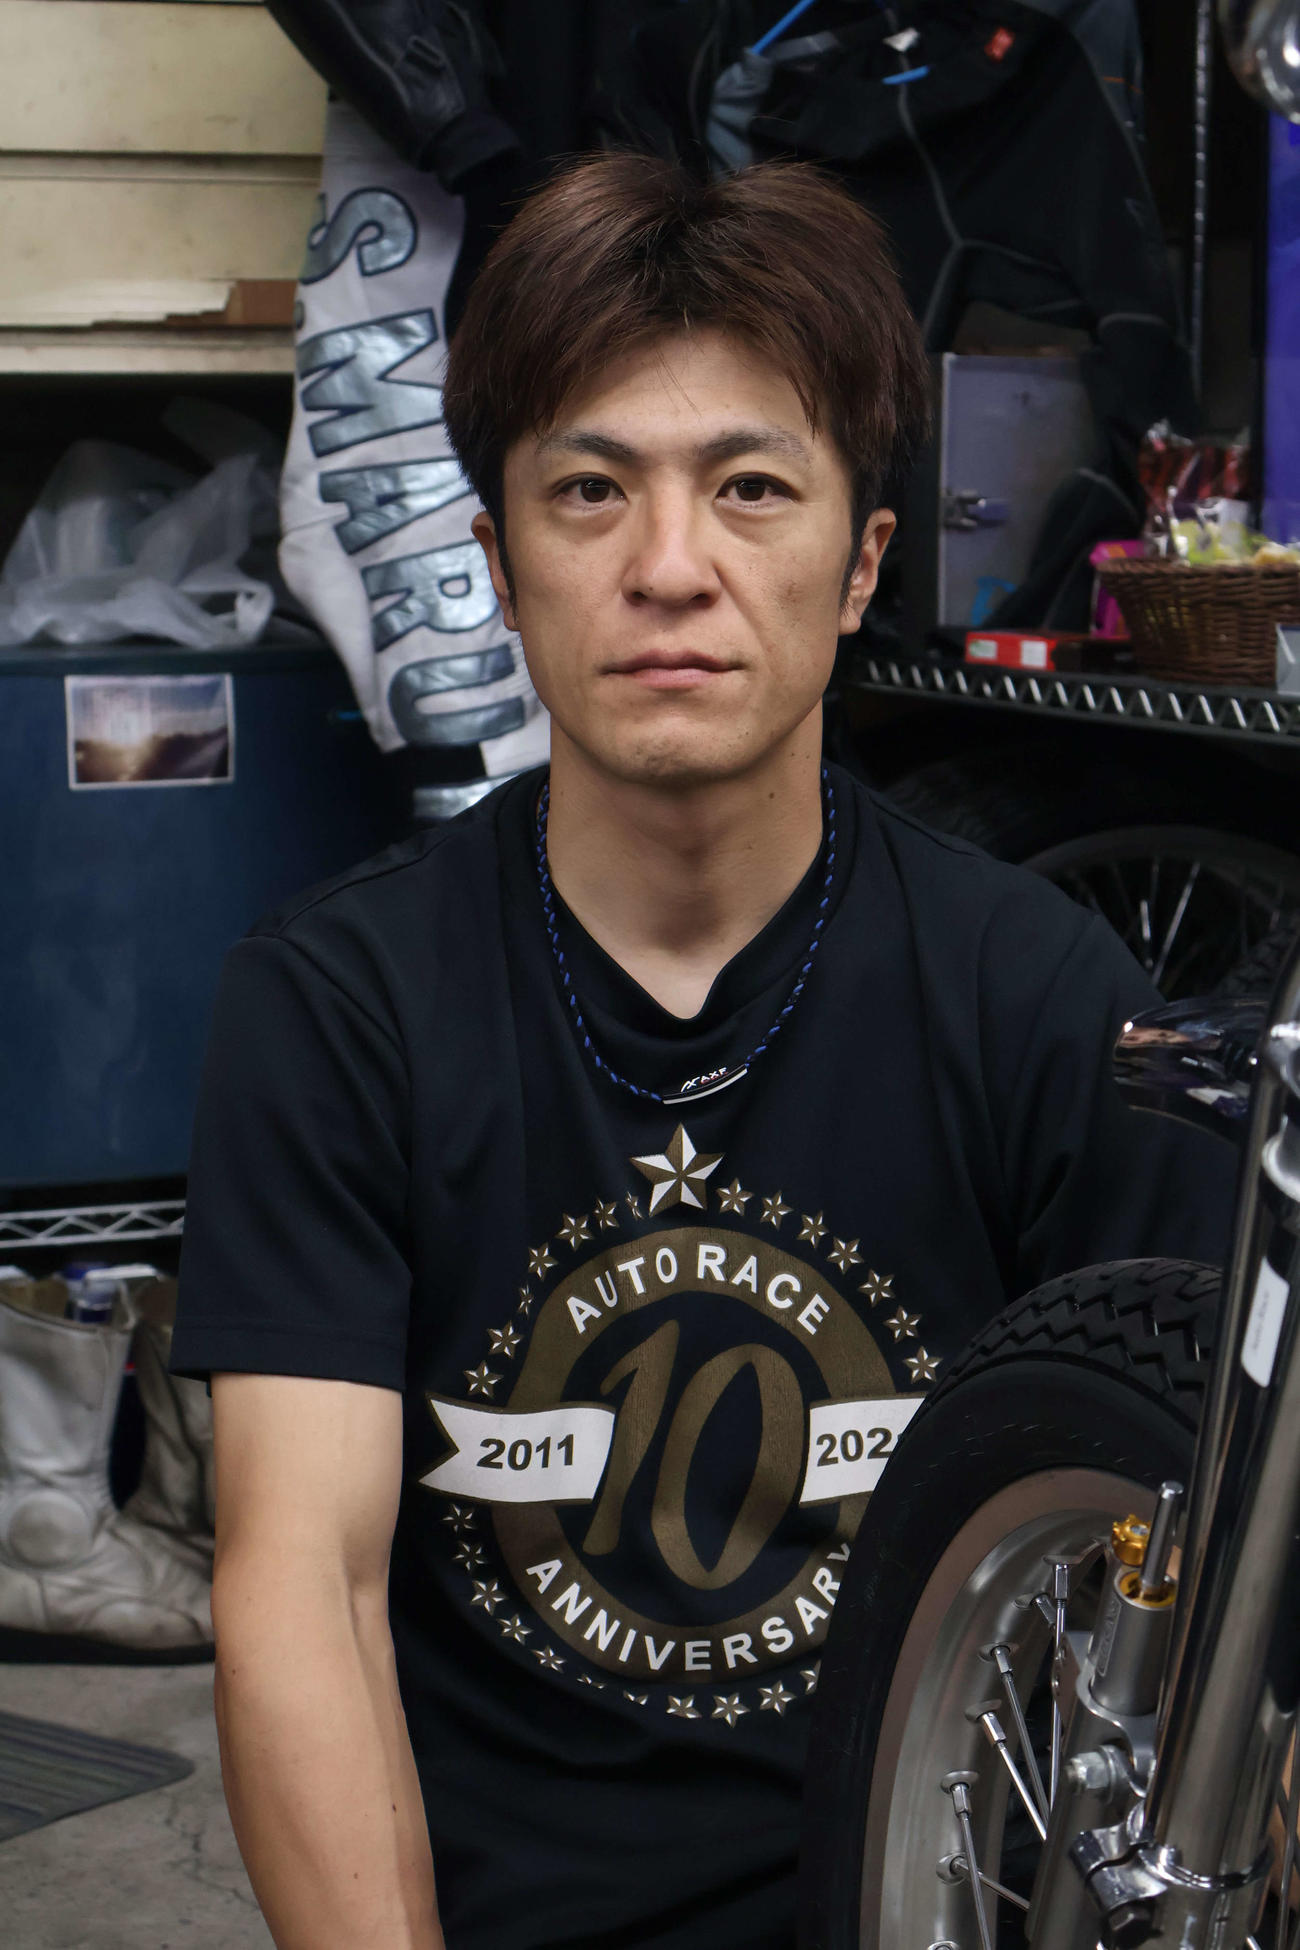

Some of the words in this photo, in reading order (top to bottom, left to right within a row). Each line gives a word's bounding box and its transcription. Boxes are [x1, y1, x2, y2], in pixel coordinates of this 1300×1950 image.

[565, 1247, 679, 1333] AUTO
[697, 1244, 831, 1335] RACE
[476, 1433, 575, 1471] 2011
[582, 1319, 802, 1590] 10
[816, 1427, 903, 1467] 202
